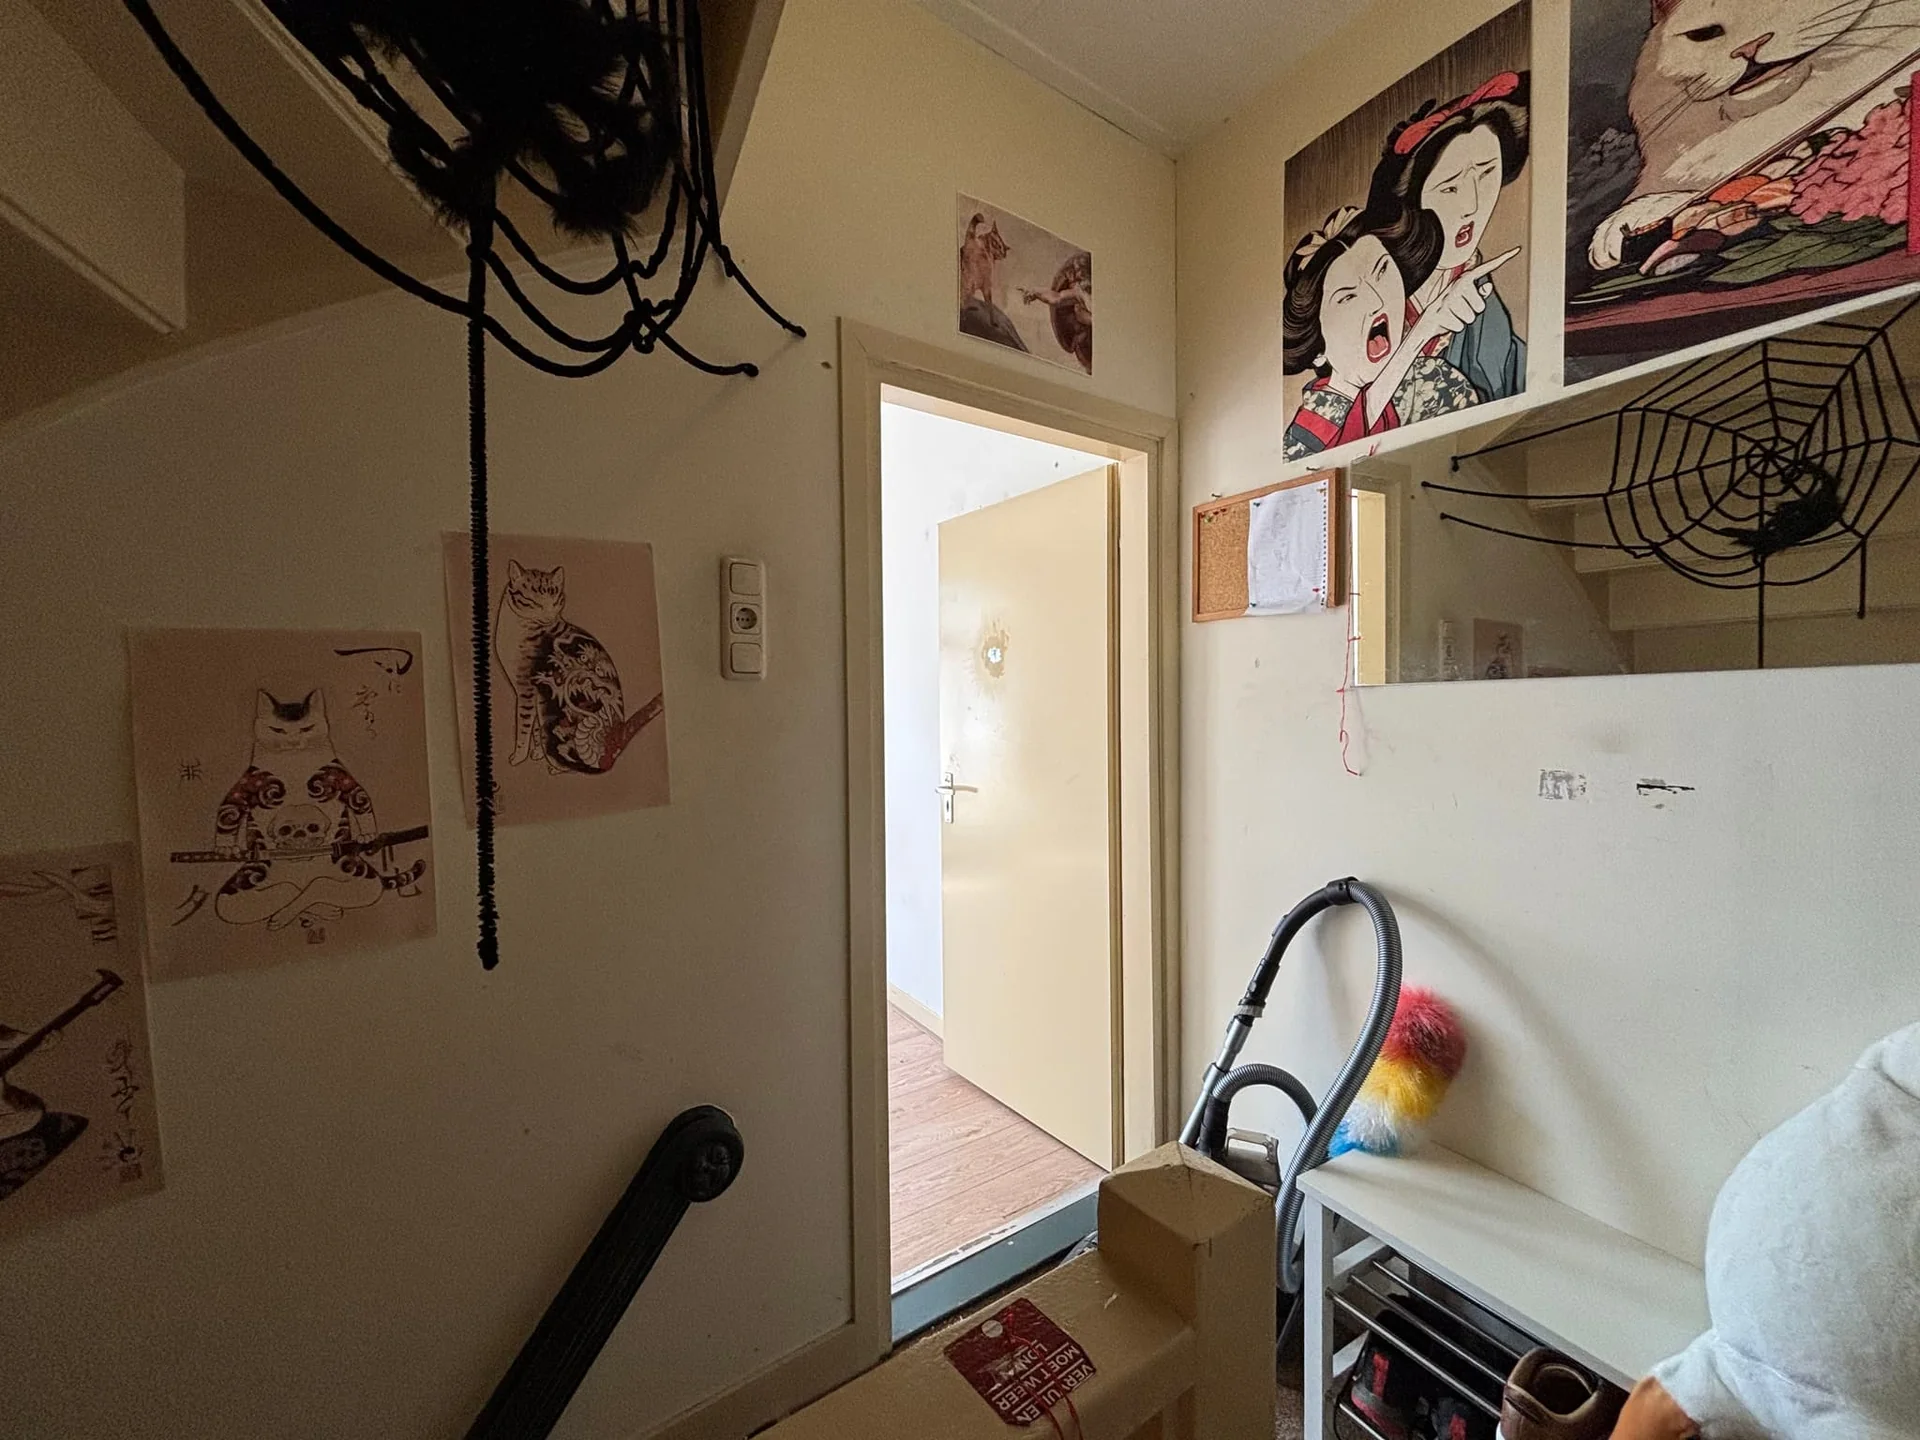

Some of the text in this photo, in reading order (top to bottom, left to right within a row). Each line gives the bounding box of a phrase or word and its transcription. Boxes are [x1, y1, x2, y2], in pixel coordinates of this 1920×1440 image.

[996, 1346, 1081, 1411] MOET WEER
[999, 1341, 1048, 1380] LONN
